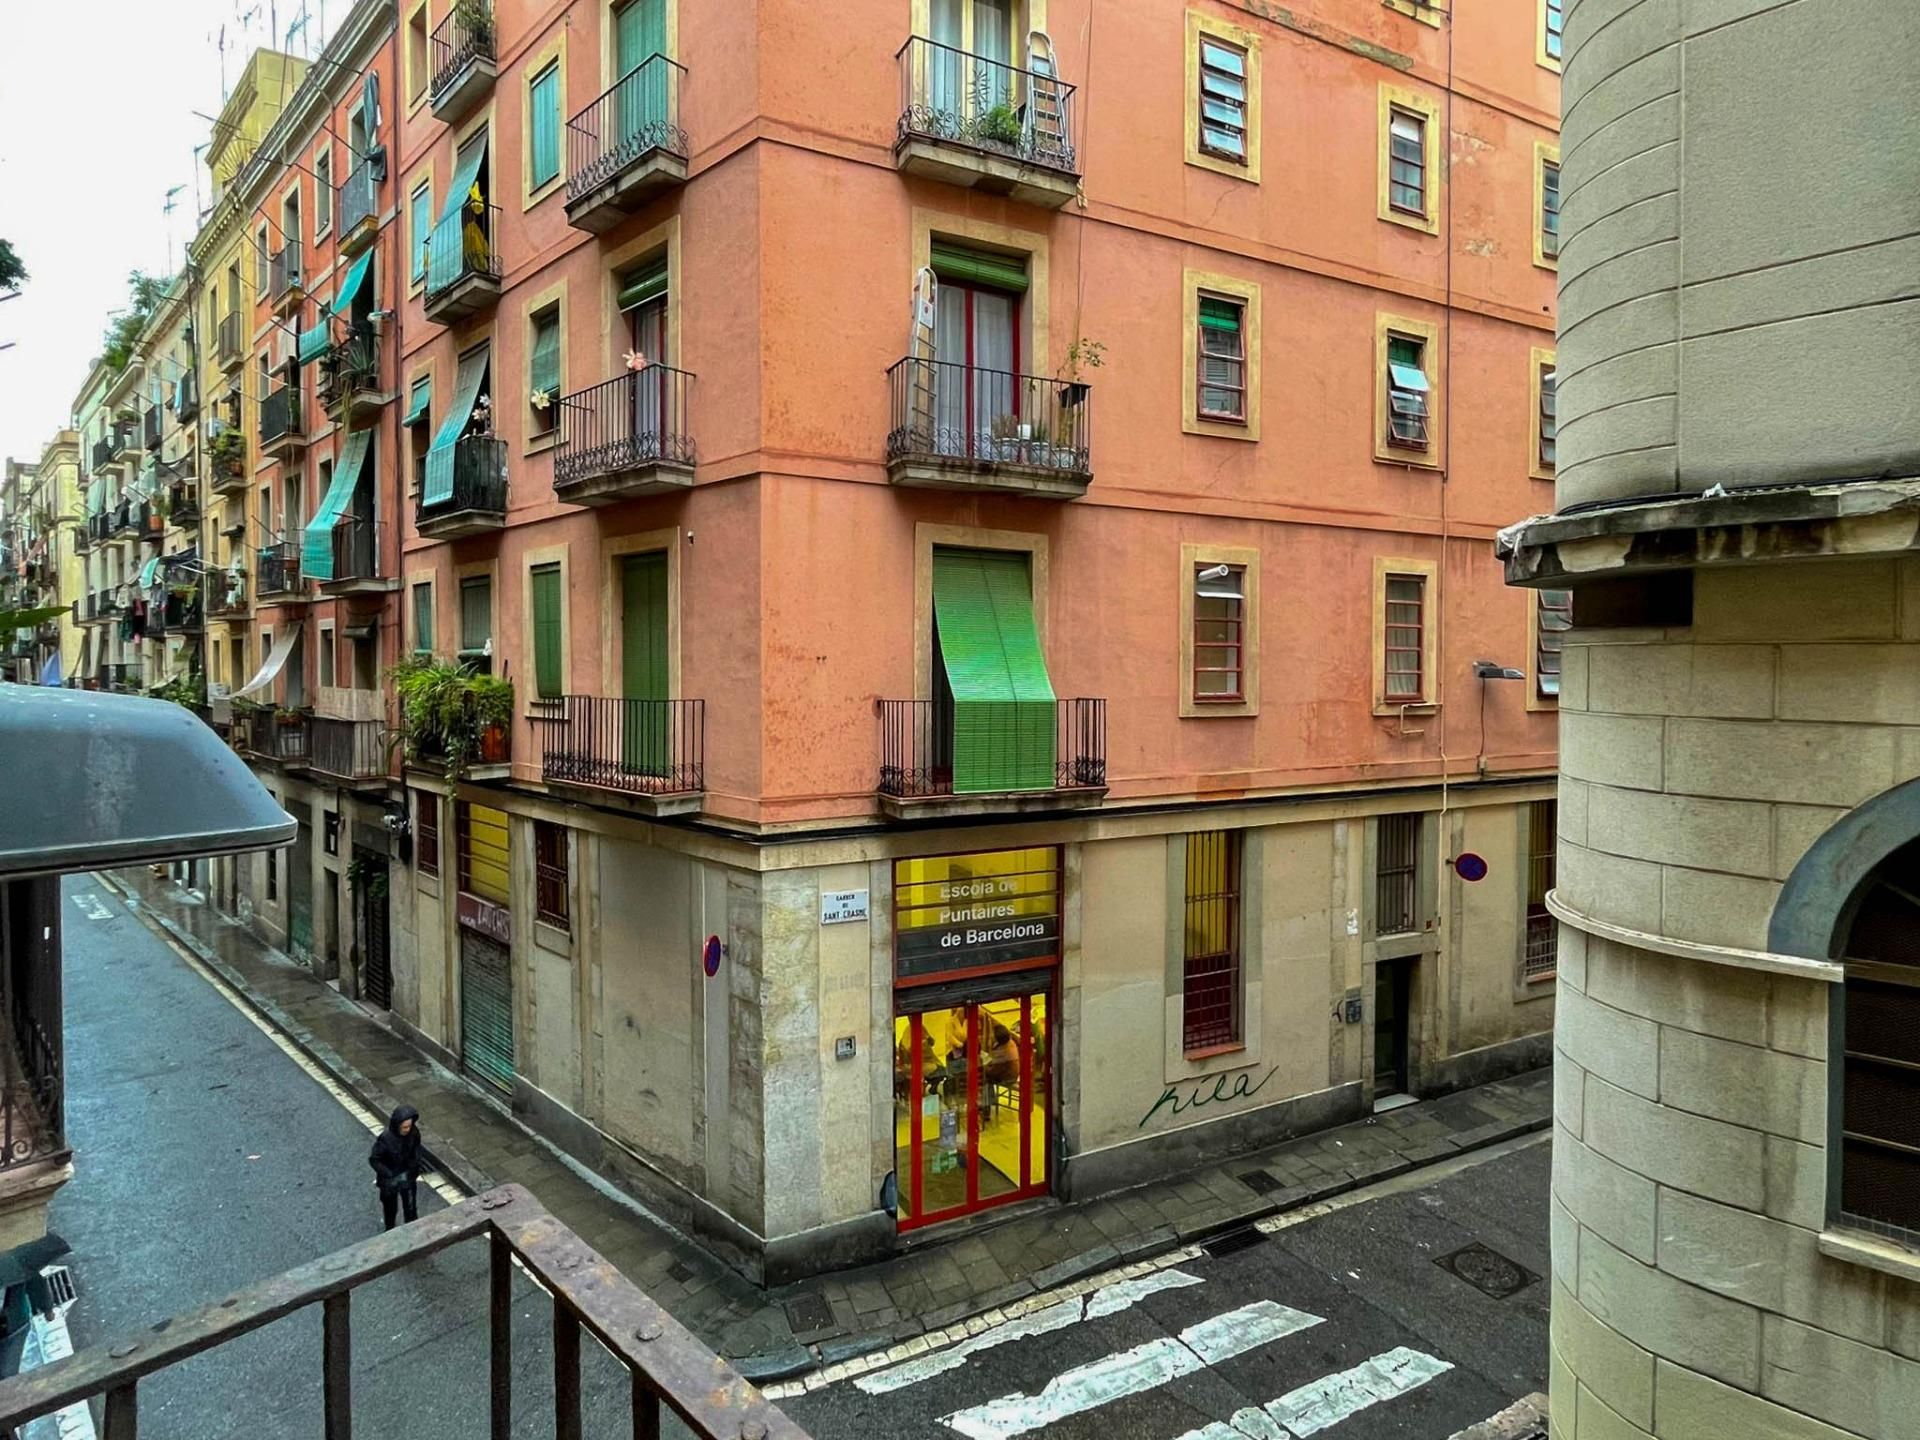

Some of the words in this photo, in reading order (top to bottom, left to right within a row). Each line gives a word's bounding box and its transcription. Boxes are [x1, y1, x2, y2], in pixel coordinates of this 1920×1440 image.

[940, 882, 994, 899] Escola
[998, 878, 1018, 891] de
[824, 911, 840, 920] SANT
[939, 904, 1015, 924] Puntaires
[941, 932, 962, 948] de
[966, 923, 1045, 945] Barcelona
